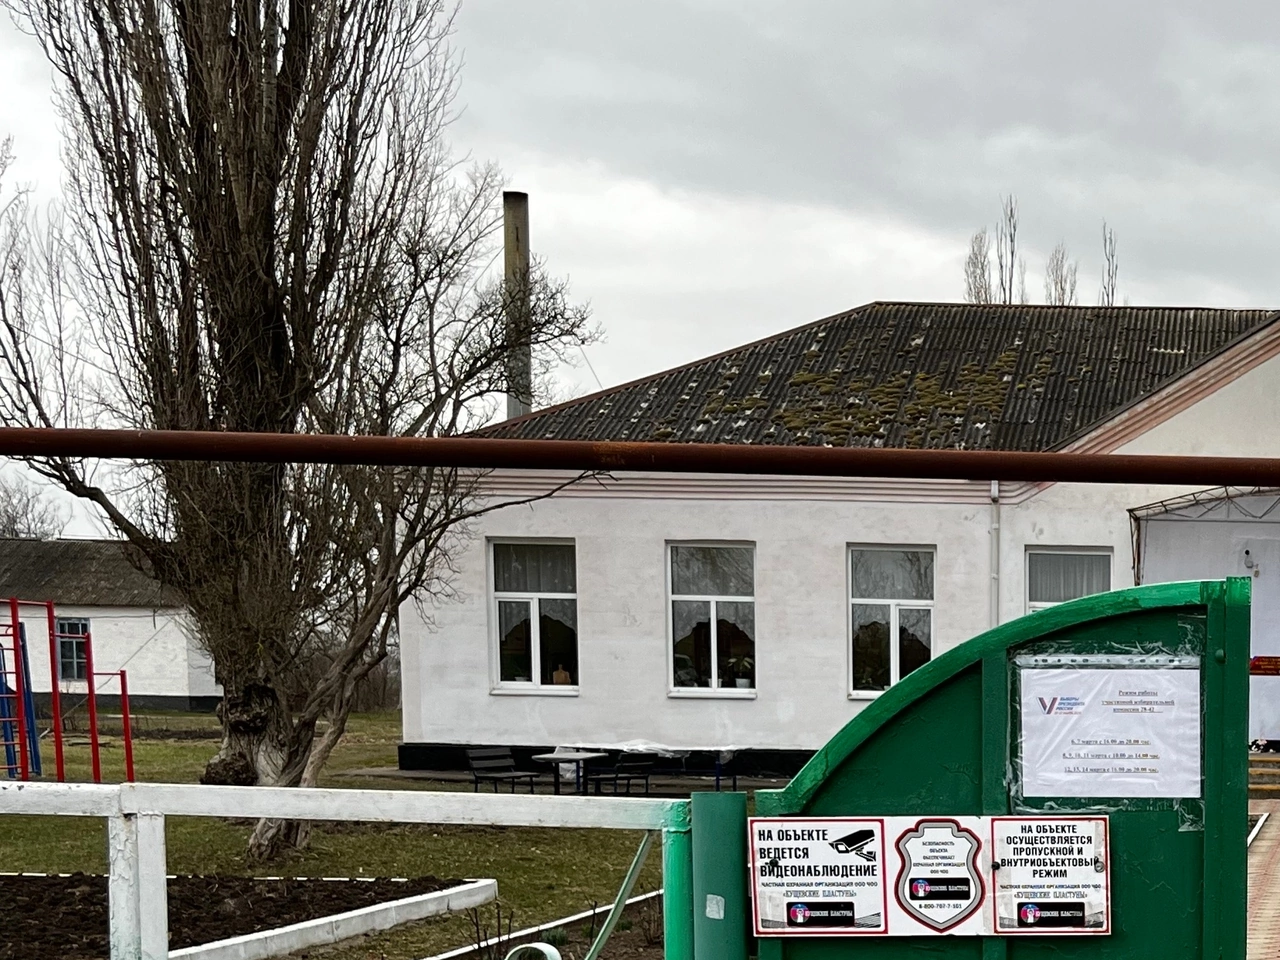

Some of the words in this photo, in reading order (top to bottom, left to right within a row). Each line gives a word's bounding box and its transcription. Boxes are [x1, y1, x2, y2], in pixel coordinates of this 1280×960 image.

[1020, 825, 1033, 834] НА
[1036, 824, 1077, 834] ОБЪЕКТЕ
[758, 829, 773, 841] НА
[778, 829, 828, 841] ОБЪЕКТЕ
[1006, 836, 1092, 846] ОСУЩЕСТВЛЯЕТСЯ
[759, 847, 810, 861] ВЕДЕТСЯ
[1013, 846, 1074, 856] ПРОПУСКНОЙ
[1077, 847, 1084, 856] И
[760, 864, 878, 878] ВИДЕОНАБЛЮДЕНИЕ
[1032, 869, 1068, 878] РЕЖИМ
